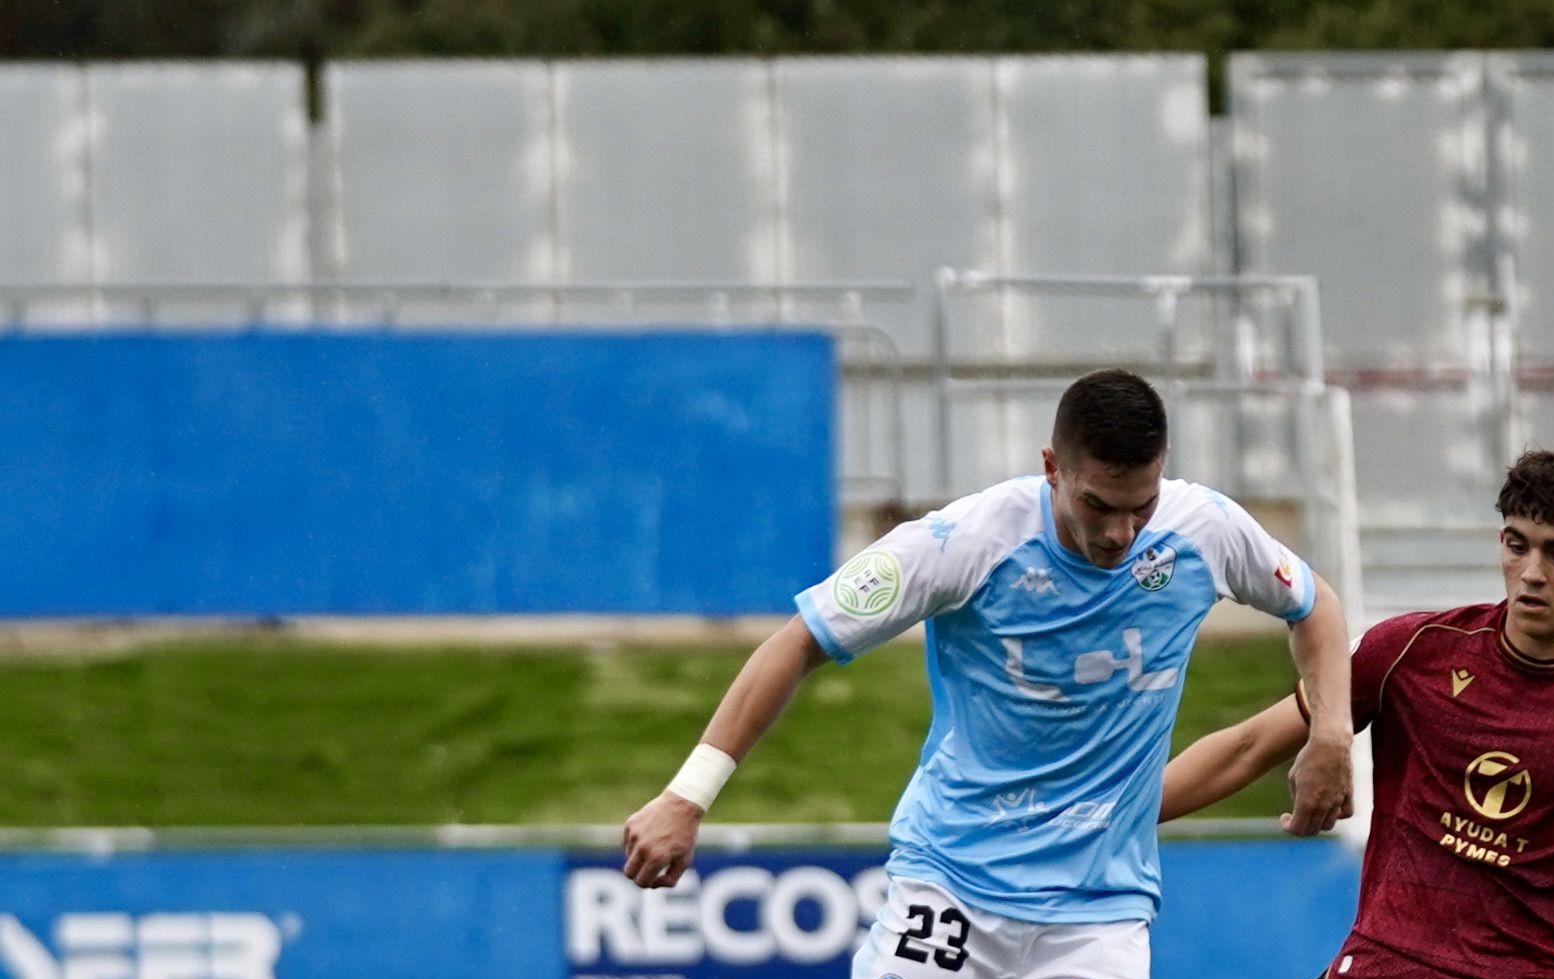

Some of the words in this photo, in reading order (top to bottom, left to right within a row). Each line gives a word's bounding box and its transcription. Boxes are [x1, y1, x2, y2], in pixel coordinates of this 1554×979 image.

[1440, 811, 1507, 848] AYUDA
[1516, 837, 1529, 853] T
[1440, 833, 1511, 867] PYMES
[895, 904, 971, 972] 23
